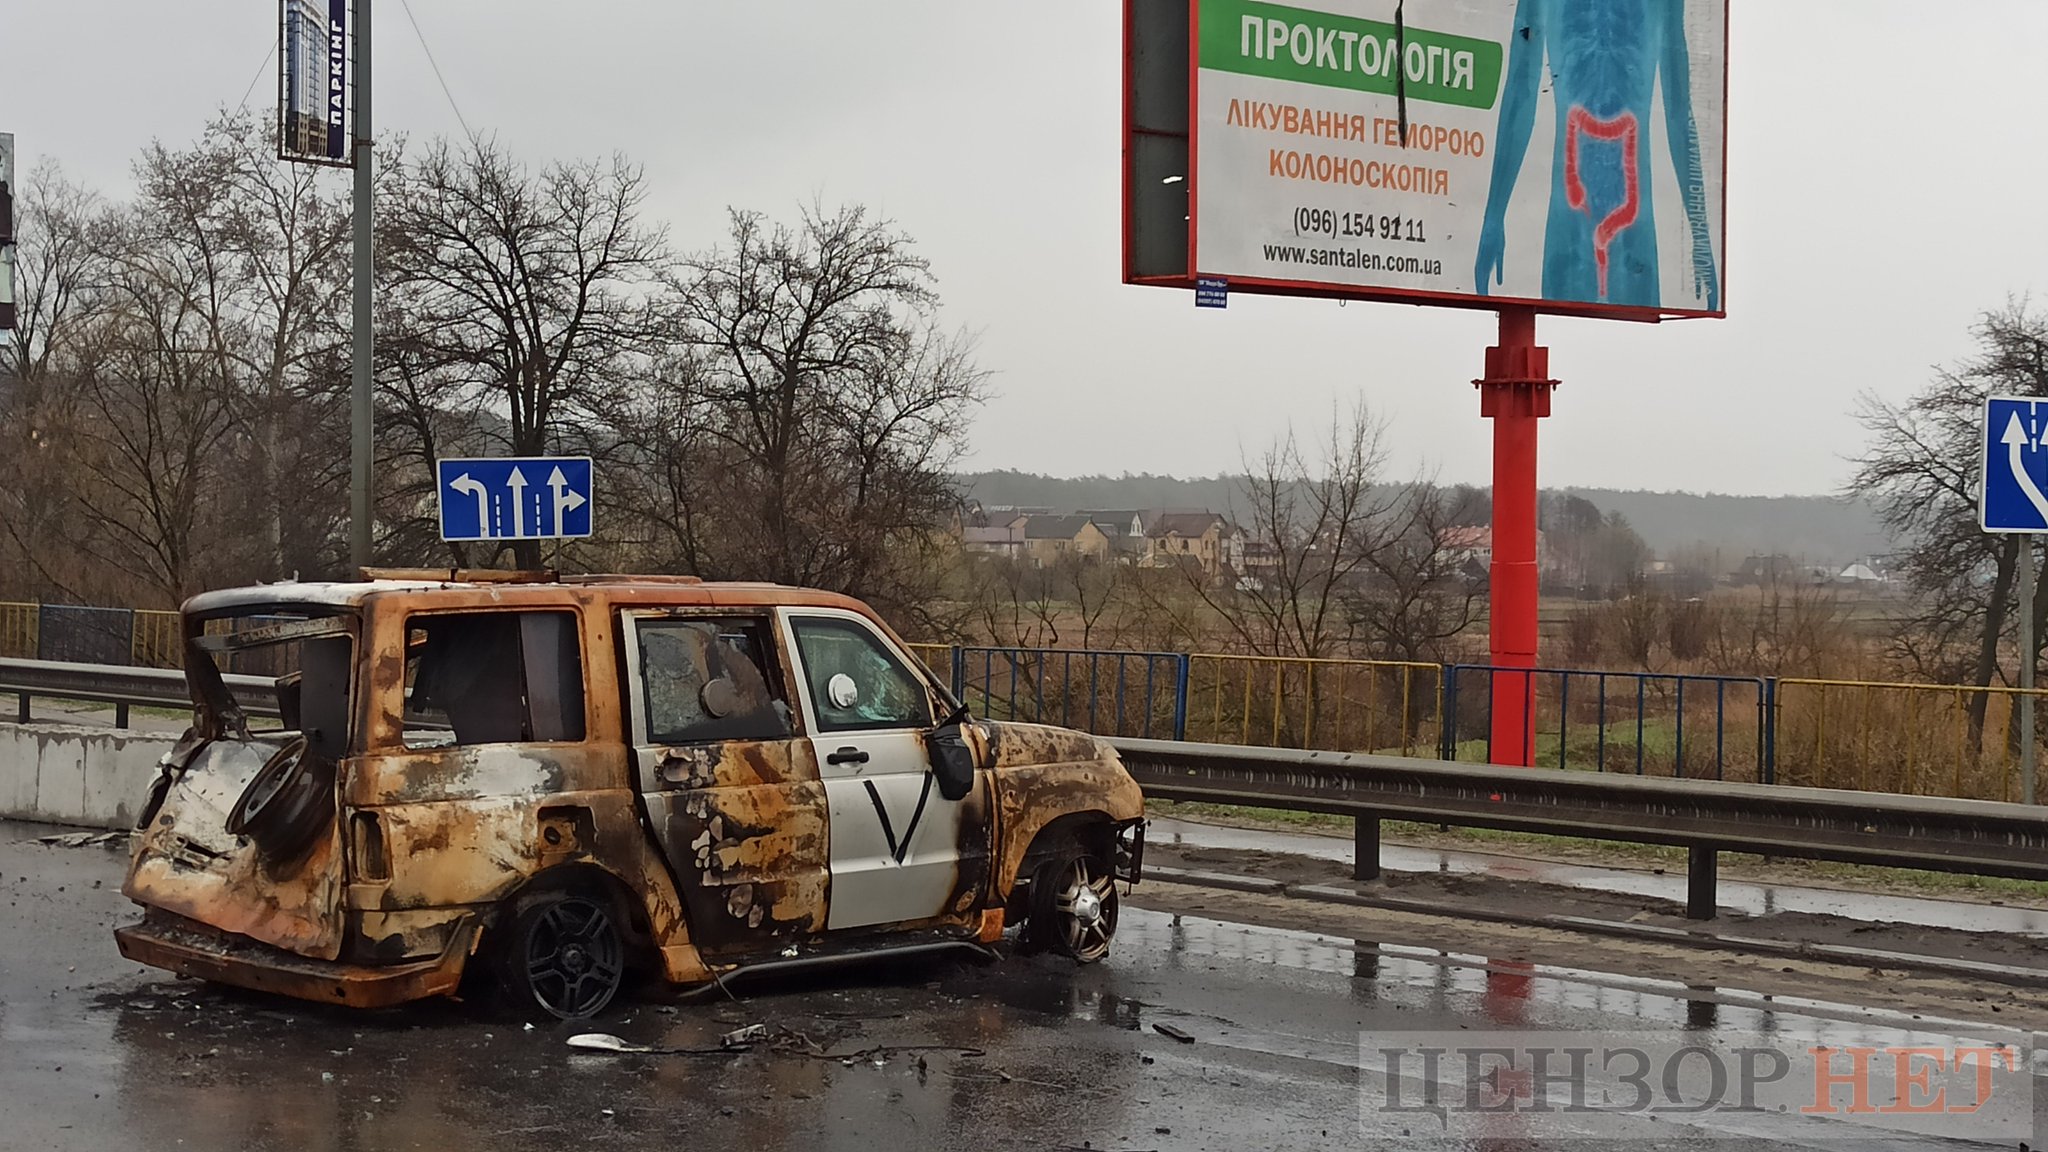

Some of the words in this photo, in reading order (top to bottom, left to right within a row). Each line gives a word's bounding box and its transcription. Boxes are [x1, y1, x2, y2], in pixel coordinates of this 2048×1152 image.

[331, 20, 342, 125] ПАРКІНГ
[1241, 14, 1474, 90] ПРОКТОЛОГІЯ
[1227, 98, 1365, 143] ЛІКУВАННЯ
[1269, 148, 1449, 195] КОЛОНОСКОПІЯ
[1294, 207, 1337, 240] (096)
[1342, 211, 1375, 238] 154
[1380, 214, 1401, 241] 91
[1405, 218, 1426, 243] 11
[1263, 243, 1442, 276] www.santalen.com.ua
[863, 770, 933, 866] V
